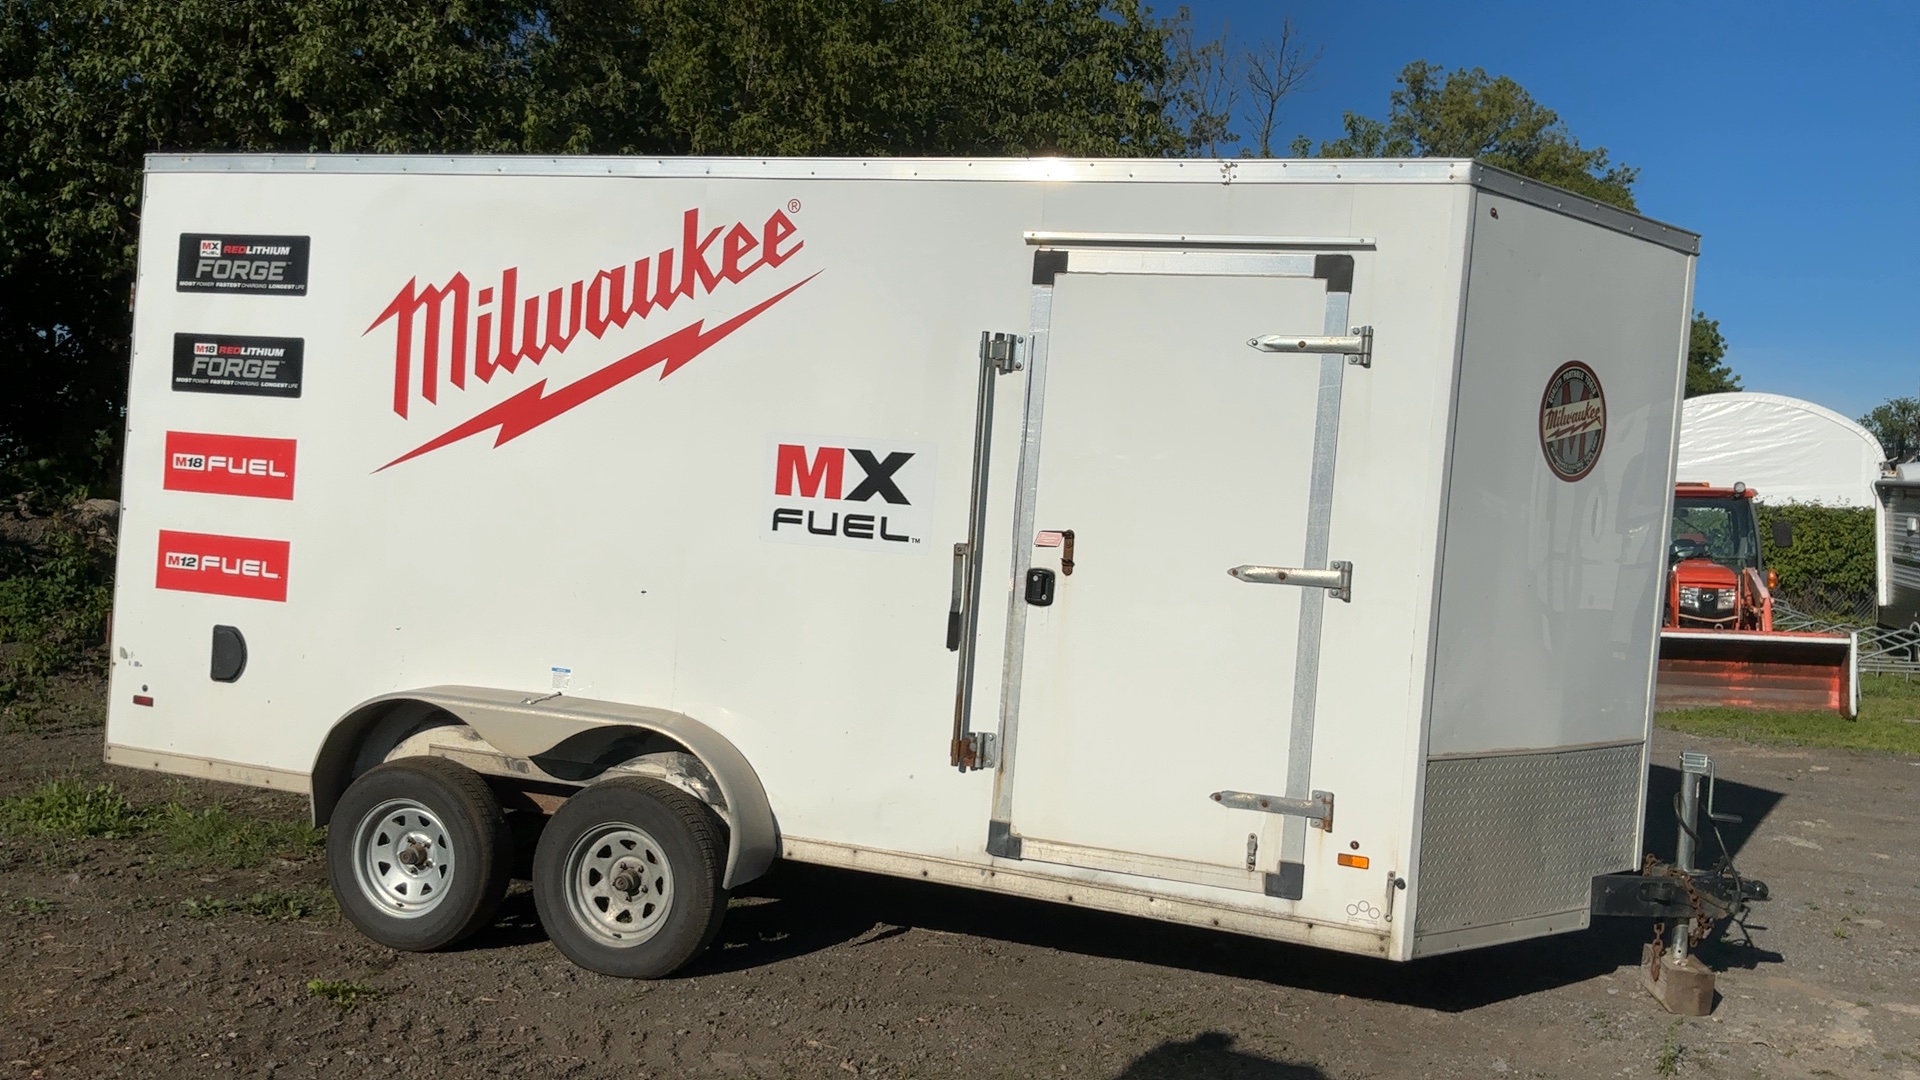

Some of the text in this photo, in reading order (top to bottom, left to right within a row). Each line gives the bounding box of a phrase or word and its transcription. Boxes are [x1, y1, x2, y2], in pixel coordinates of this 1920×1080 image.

[202, 242, 219, 250] MX
[223, 245, 290, 255] REDLITHIUM
[219, 345, 285, 357] REDLITHIUM
[1545, 401, 1600, 430] Milwaukee
[175, 455, 288, 478] M18 FUEL
[775, 443, 916, 506] MX
[168, 555, 281, 579] M12 FUEL
